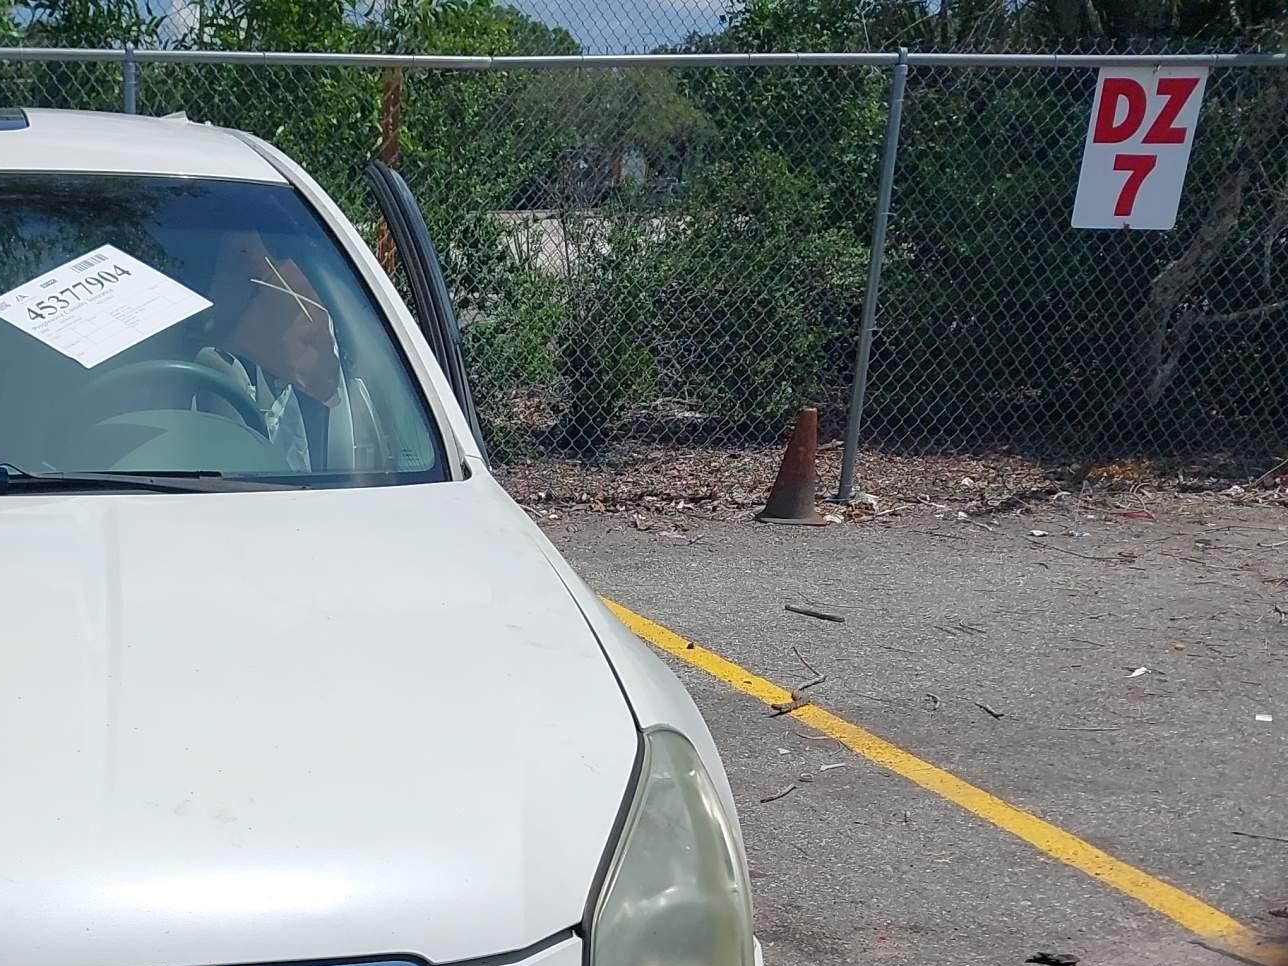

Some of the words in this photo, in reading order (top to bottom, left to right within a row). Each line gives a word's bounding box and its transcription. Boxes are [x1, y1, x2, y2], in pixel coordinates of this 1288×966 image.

[1092, 77, 1201, 145] DZ
[1112, 154, 1158, 217] 7
[25, 263, 132, 323] 45377904
